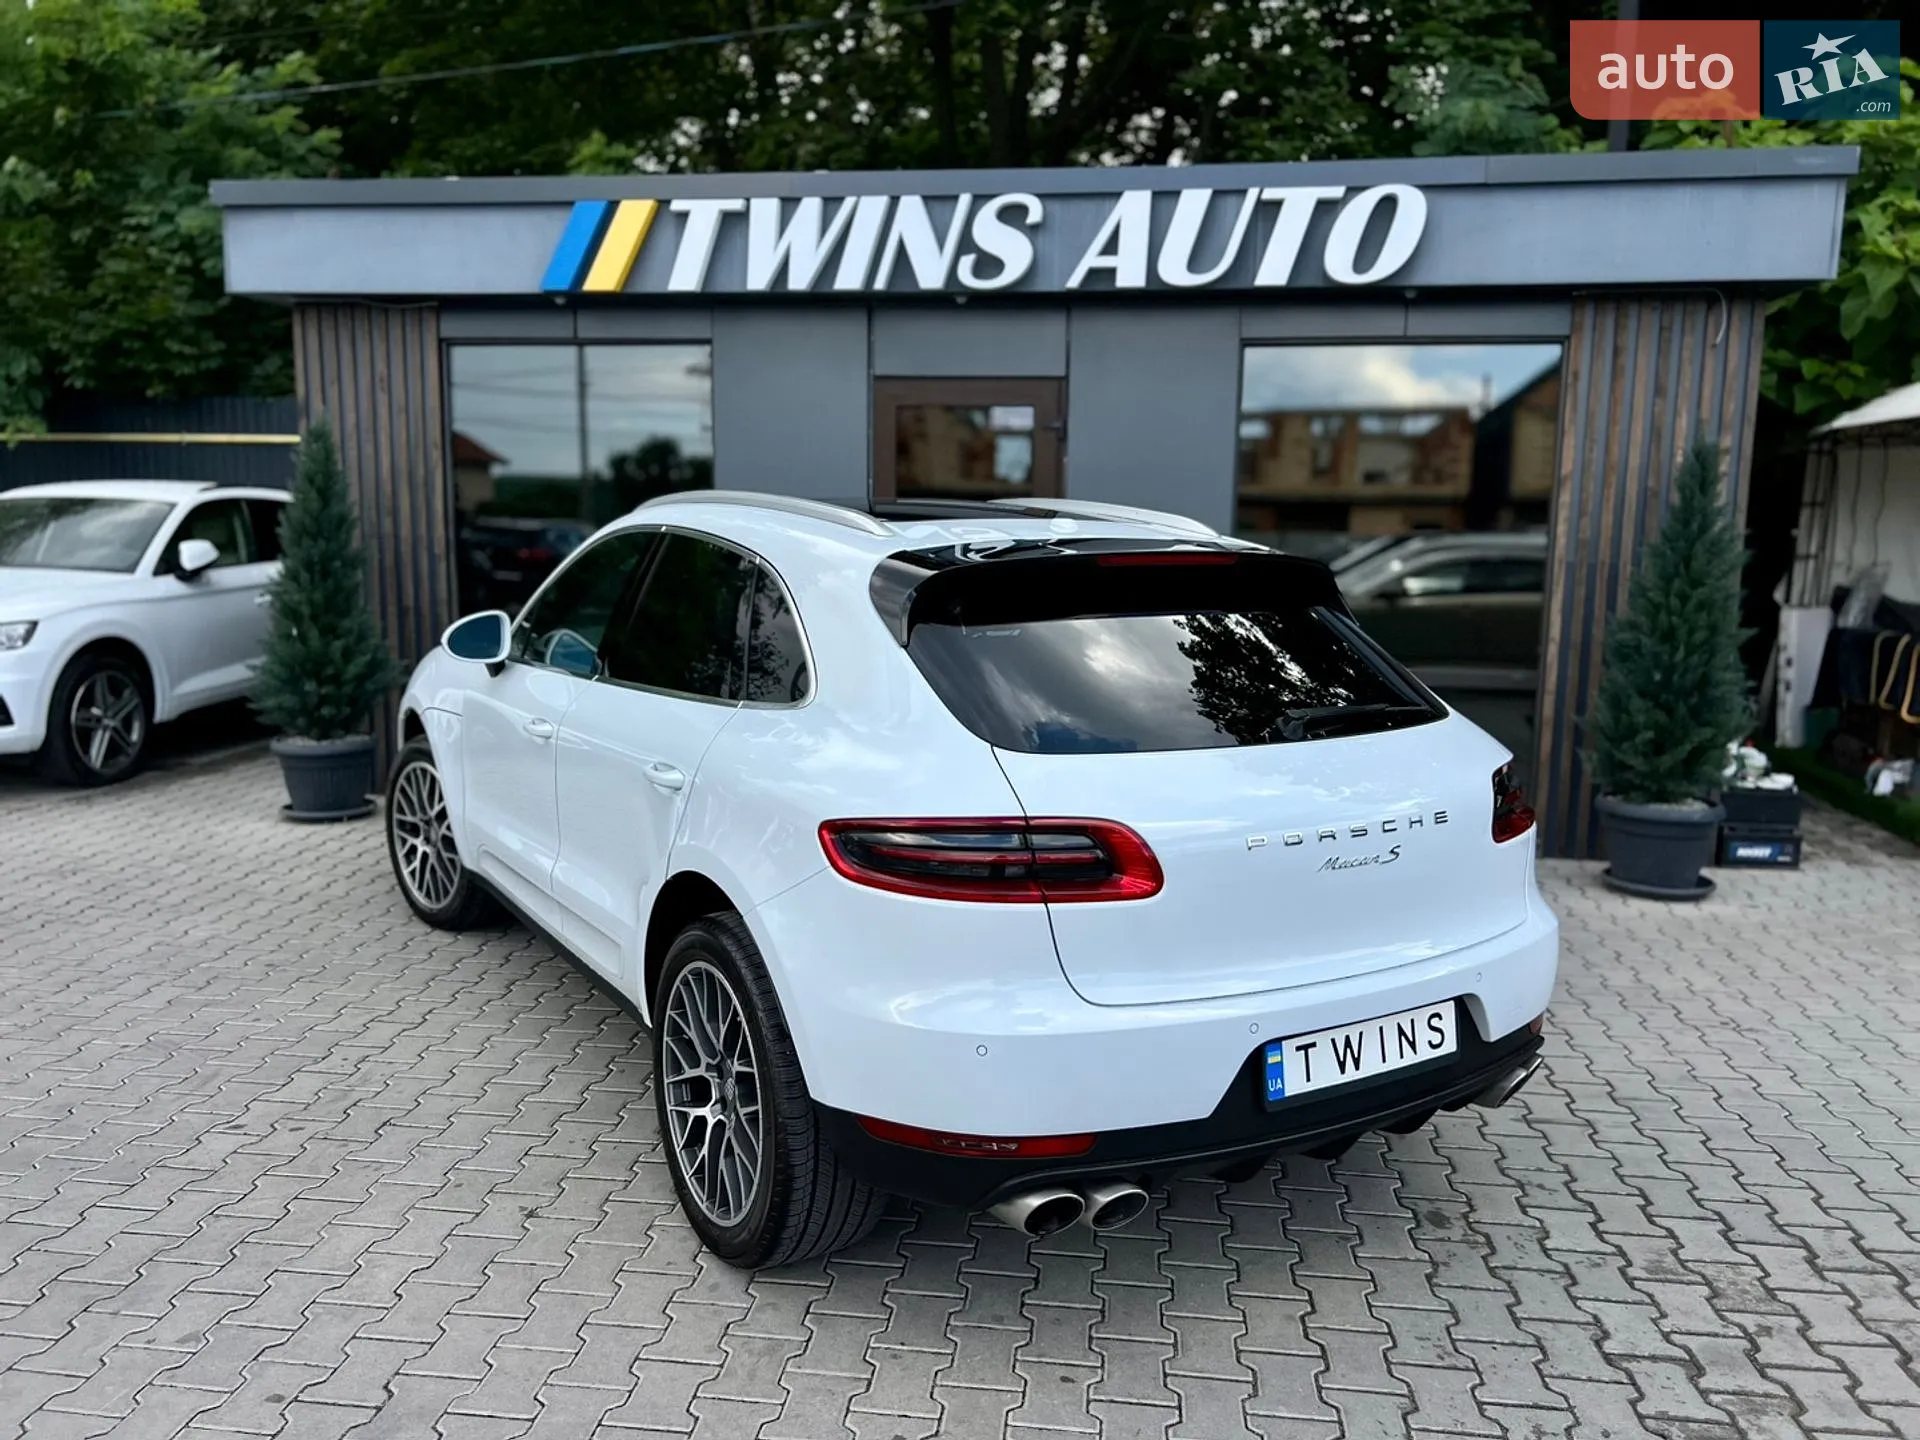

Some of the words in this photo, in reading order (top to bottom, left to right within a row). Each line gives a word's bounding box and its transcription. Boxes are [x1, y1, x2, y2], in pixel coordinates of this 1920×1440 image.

[666, 191, 1044, 292] TWINS
[1064, 183, 1429, 289] AUTO
[1246, 810, 1449, 851] PORSCHE
[1316, 855, 1380, 873] Macan
[1379, 843, 1402, 866] S
[1295, 1011, 1446, 1084] TWINS
[1267, 1078, 1283, 1092] UA
